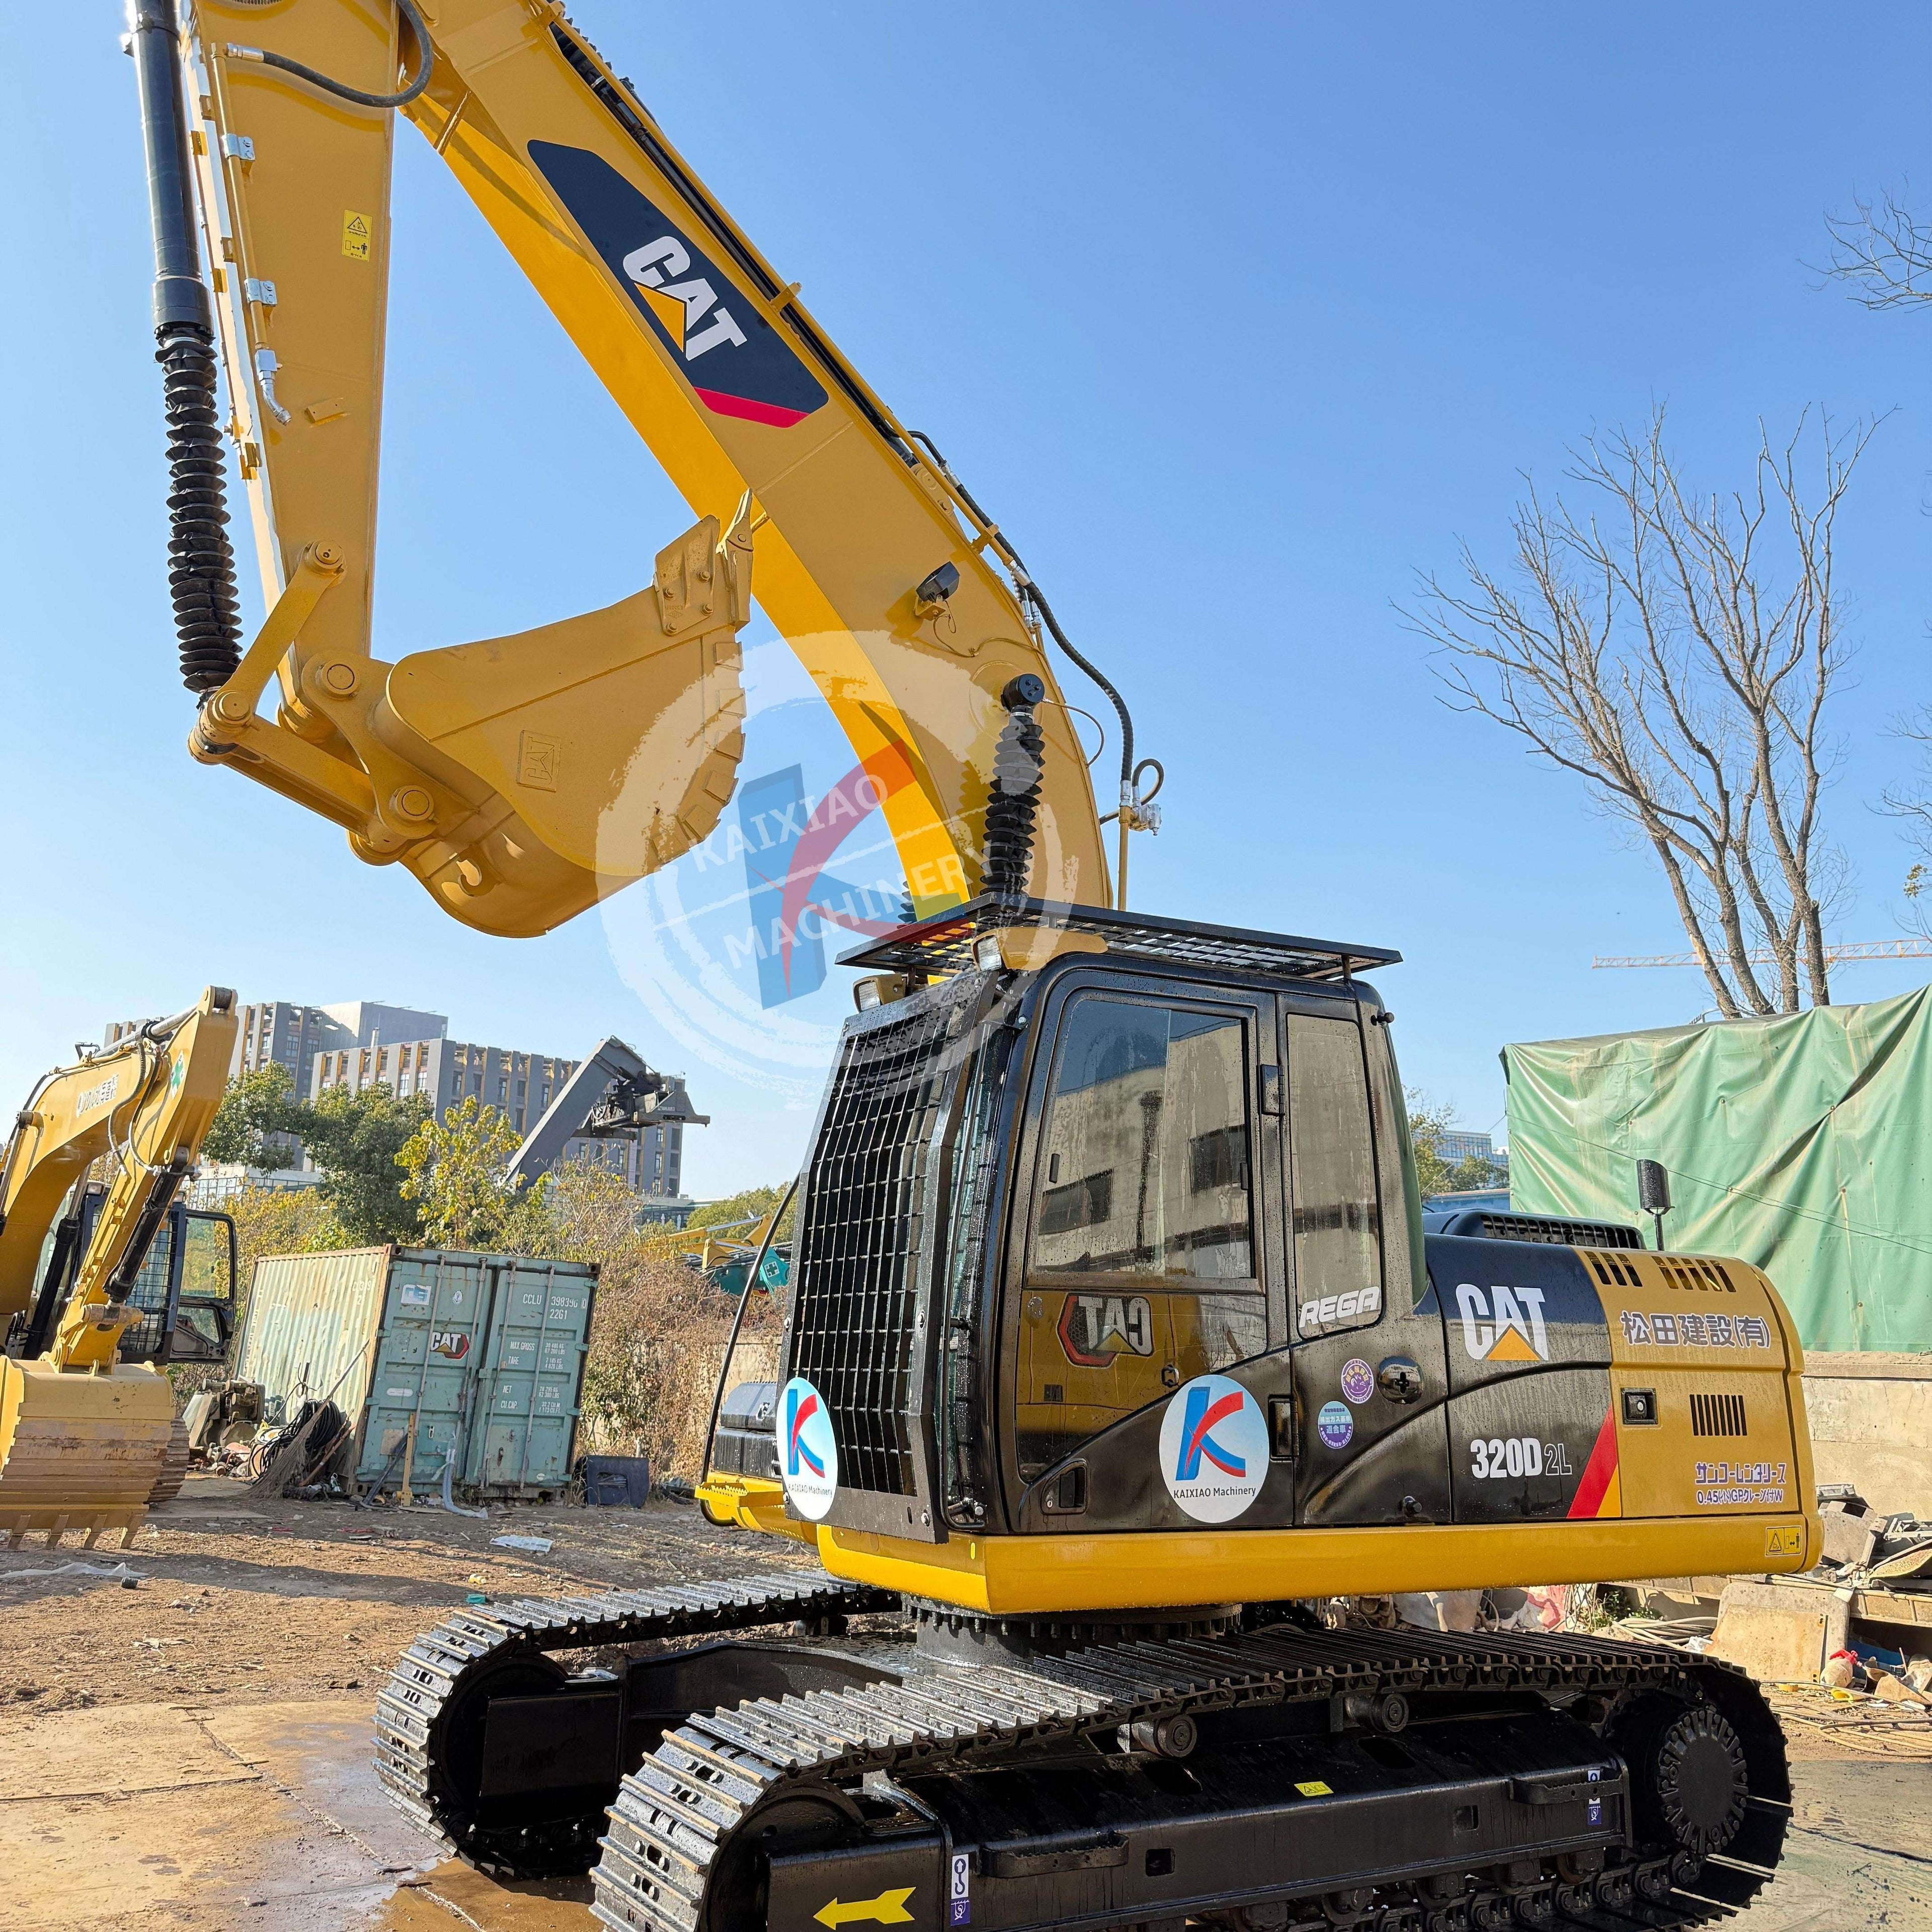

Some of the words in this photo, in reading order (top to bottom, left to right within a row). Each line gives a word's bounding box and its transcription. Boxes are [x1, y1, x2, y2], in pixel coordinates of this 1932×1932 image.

[623, 236, 747, 361] CAT
[523, 1294, 542, 1305] CCLU
[551, 1296, 578, 1308] 398396
[1299, 1286, 1380, 1328] REGA
[549, 1309, 568, 1320] 22G1
[1456, 1283, 1549, 1360] CAT
[1620, 1311, 1770, 1348] 松田建設(有)
[430, 1332, 461, 1353] CAT
[508, 1356, 519, 1364] TARE
[503, 1385, 512, 1393] NET
[1696, 1462, 1787, 1484] サンコーレンタリース
[809, 1485, 832, 1498] Machinery
[1173, 1488, 1211, 1499] KAIXIAO
[1213, 1486, 1256, 1497] Machinery
